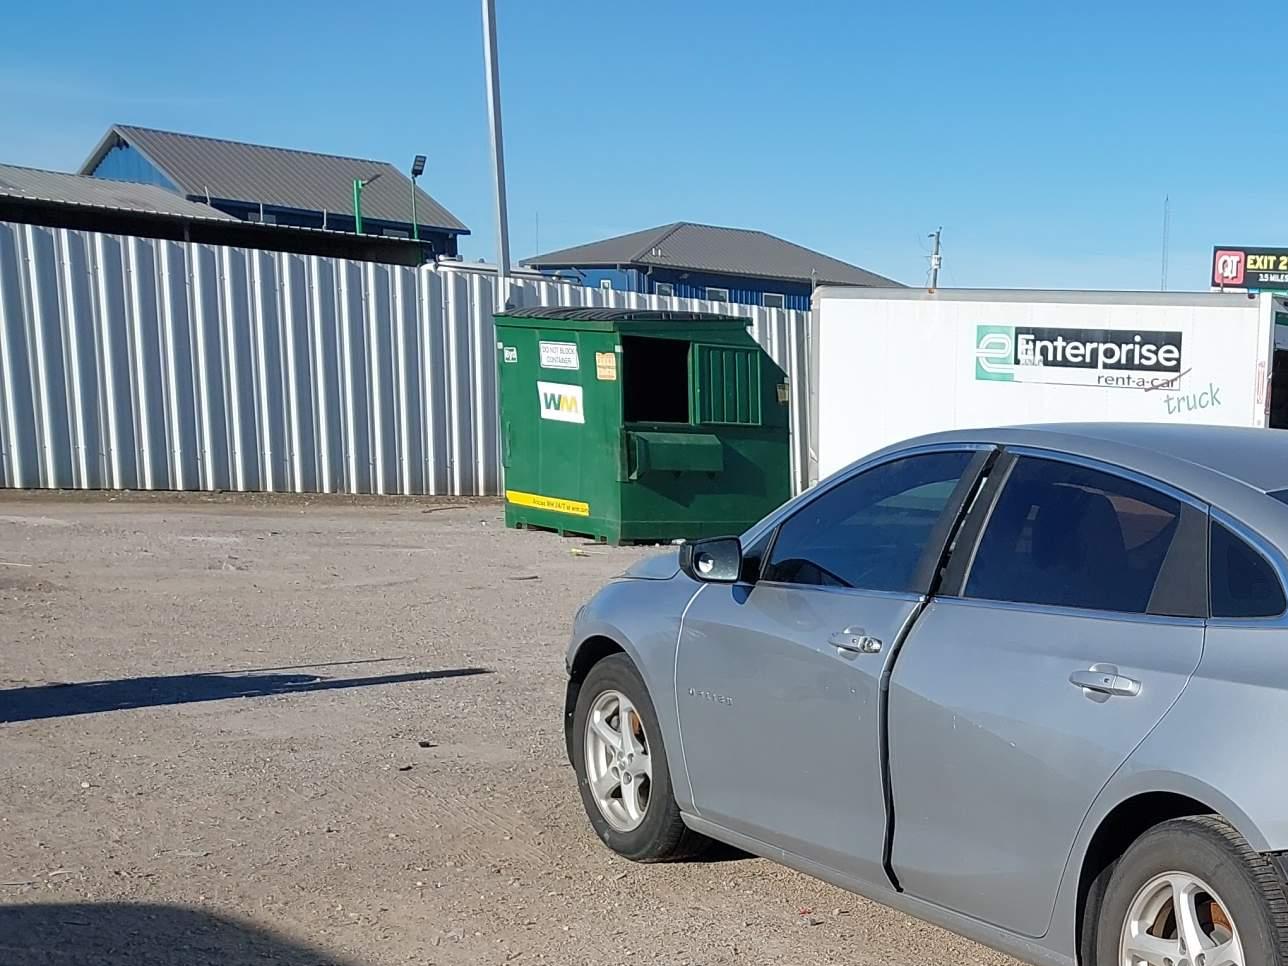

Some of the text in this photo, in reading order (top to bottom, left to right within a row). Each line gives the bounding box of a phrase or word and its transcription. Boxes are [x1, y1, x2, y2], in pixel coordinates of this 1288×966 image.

[1247, 255, 1276, 270] EXIT
[550, 346, 559, 354] NOT
[560, 347, 575, 355] BLOCK
[1017, 333, 1179, 370] Enterprise
[1097, 374, 1178, 390] rent-a-car
[544, 393, 578, 413] WM
[1163, 383, 1222, 415] truck
